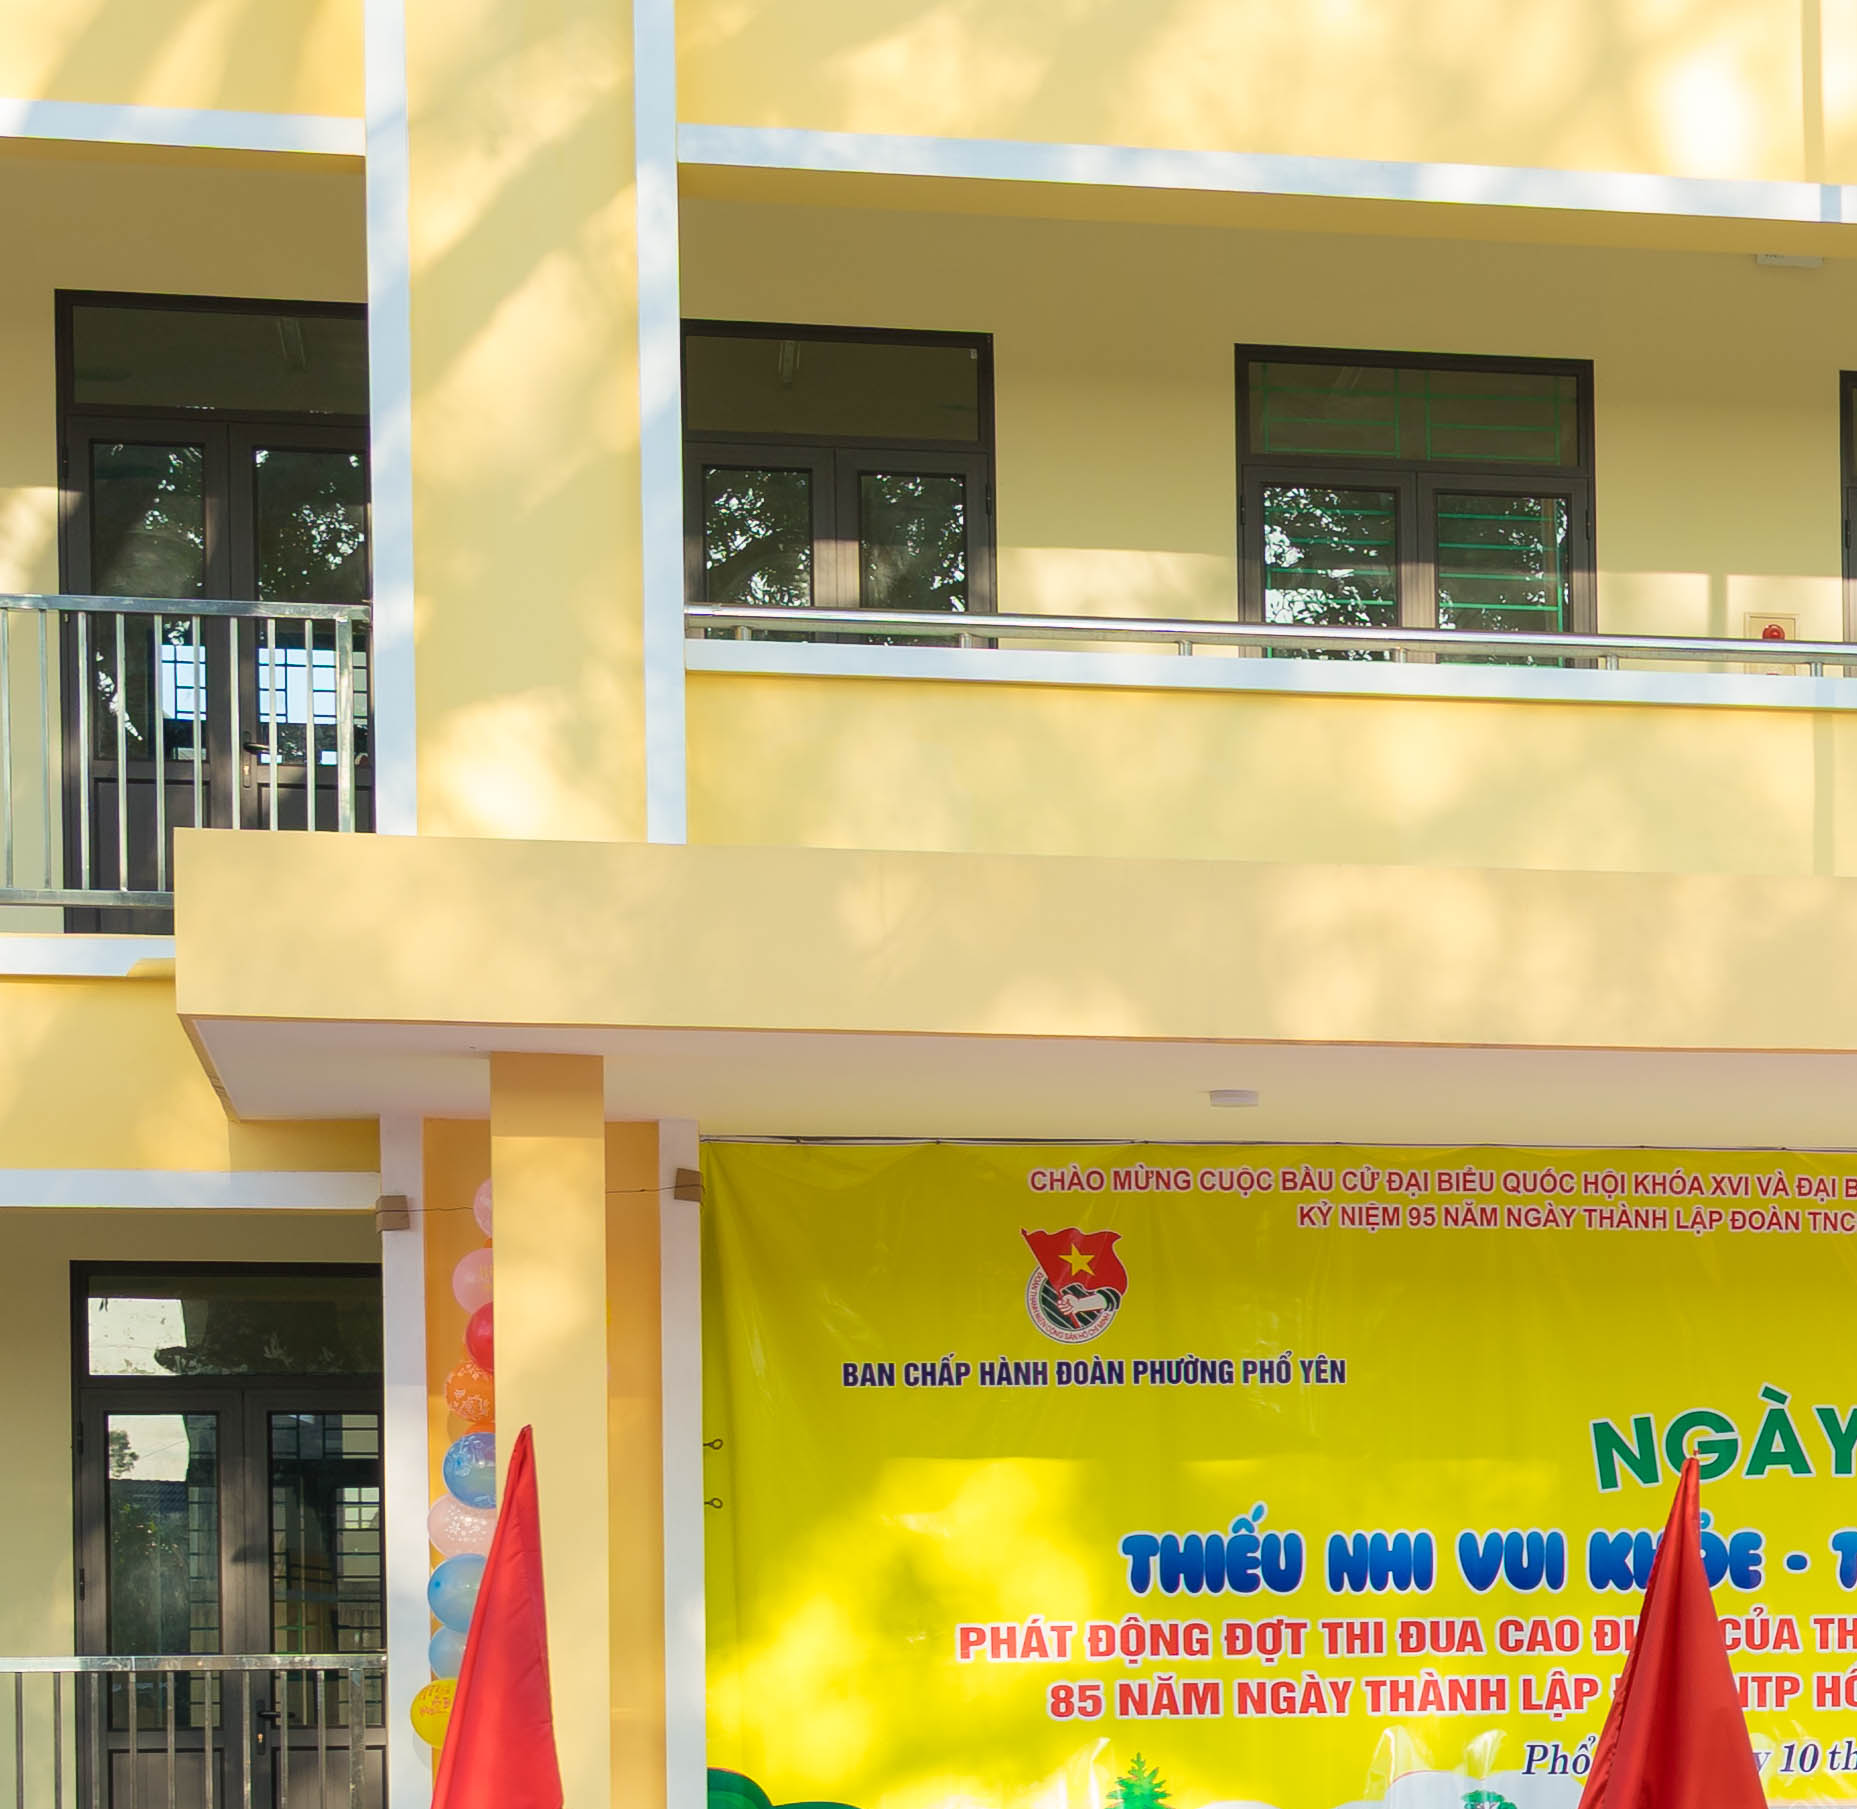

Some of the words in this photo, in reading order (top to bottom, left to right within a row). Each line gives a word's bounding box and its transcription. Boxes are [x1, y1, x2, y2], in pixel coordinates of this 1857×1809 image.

[1030, 1165, 1104, 1191] CHÀO
[1112, 1166, 1192, 1192] MỪNG
[1200, 1167, 1272, 1198] CUỘC
[1281, 1167, 1333, 1193] BẦU
[1341, 1168, 1380, 1194] CỬ
[1386, 1173, 1429, 1199] ĐẠI
[1436, 1169, 1495, 1195] BIỂU
[1503, 1170, 1576, 1196] QUỐC
[1583, 1170, 1626, 1201] HỘI
[1634, 1171, 1704, 1197] KHÓA
[1711, 1176, 1750, 1197] XVI
[1756, 1172, 1791, 1198] VÀ
[1795, 1177, 1837, 1203] ĐẠI
[1298, 1201, 1333, 1227] KỶ
[1340, 1201, 1400, 1232] NIỆM
[1408, 1207, 1436, 1228] 95
[1444, 1203, 1498, 1228] NĂM
[1507, 1203, 1576, 1229] NGÀY
[1584, 1204, 1668, 1230] THÀNH
[1675, 1205, 1723, 1236] LẬP
[1729, 1206, 1800, 1231] ĐOÀN
[843, 1364, 894, 1386] BAN
[905, 1358, 970, 1386] CHẤP
[981, 1357, 1048, 1385] HÀNH
[1056, 1356, 1124, 1385] ĐOÀN
[1133, 1355, 1233, 1384] PHƯỜNG
[1244, 1355, 1291, 1383] PHỔ
[1301, 1355, 1345, 1383] YÊN
[1121, 1504, 1302, 1593] THIẾU
[1327, 1532, 1432, 1592] NHI
[1458, 1531, 1564, 1592] VUI
[960, 1619, 1072, 1659] PHÁT
[1088, 1617, 1214, 1664] ĐỘNG
[1225, 1619, 1307, 1662] ĐỢT
[1322, 1621, 1383, 1654] THI
[1399, 1621, 1483, 1653] ĐUA
[1505, 1619, 1579, 1652] CAO
[1722, 1607, 1800, 1650] CỦA
[1051, 1685, 1102, 1717] 85
[1120, 1676, 1219, 1715] NĂM
[1238, 1674, 1351, 1714] NGÀY
[1365, 1672, 1506, 1712] THÀNH
[1523, 1671, 1598, 1717] LẬP
[1522, 1736, 1596, 1775] Phổ
[1781, 1744, 1818, 1772] 10
